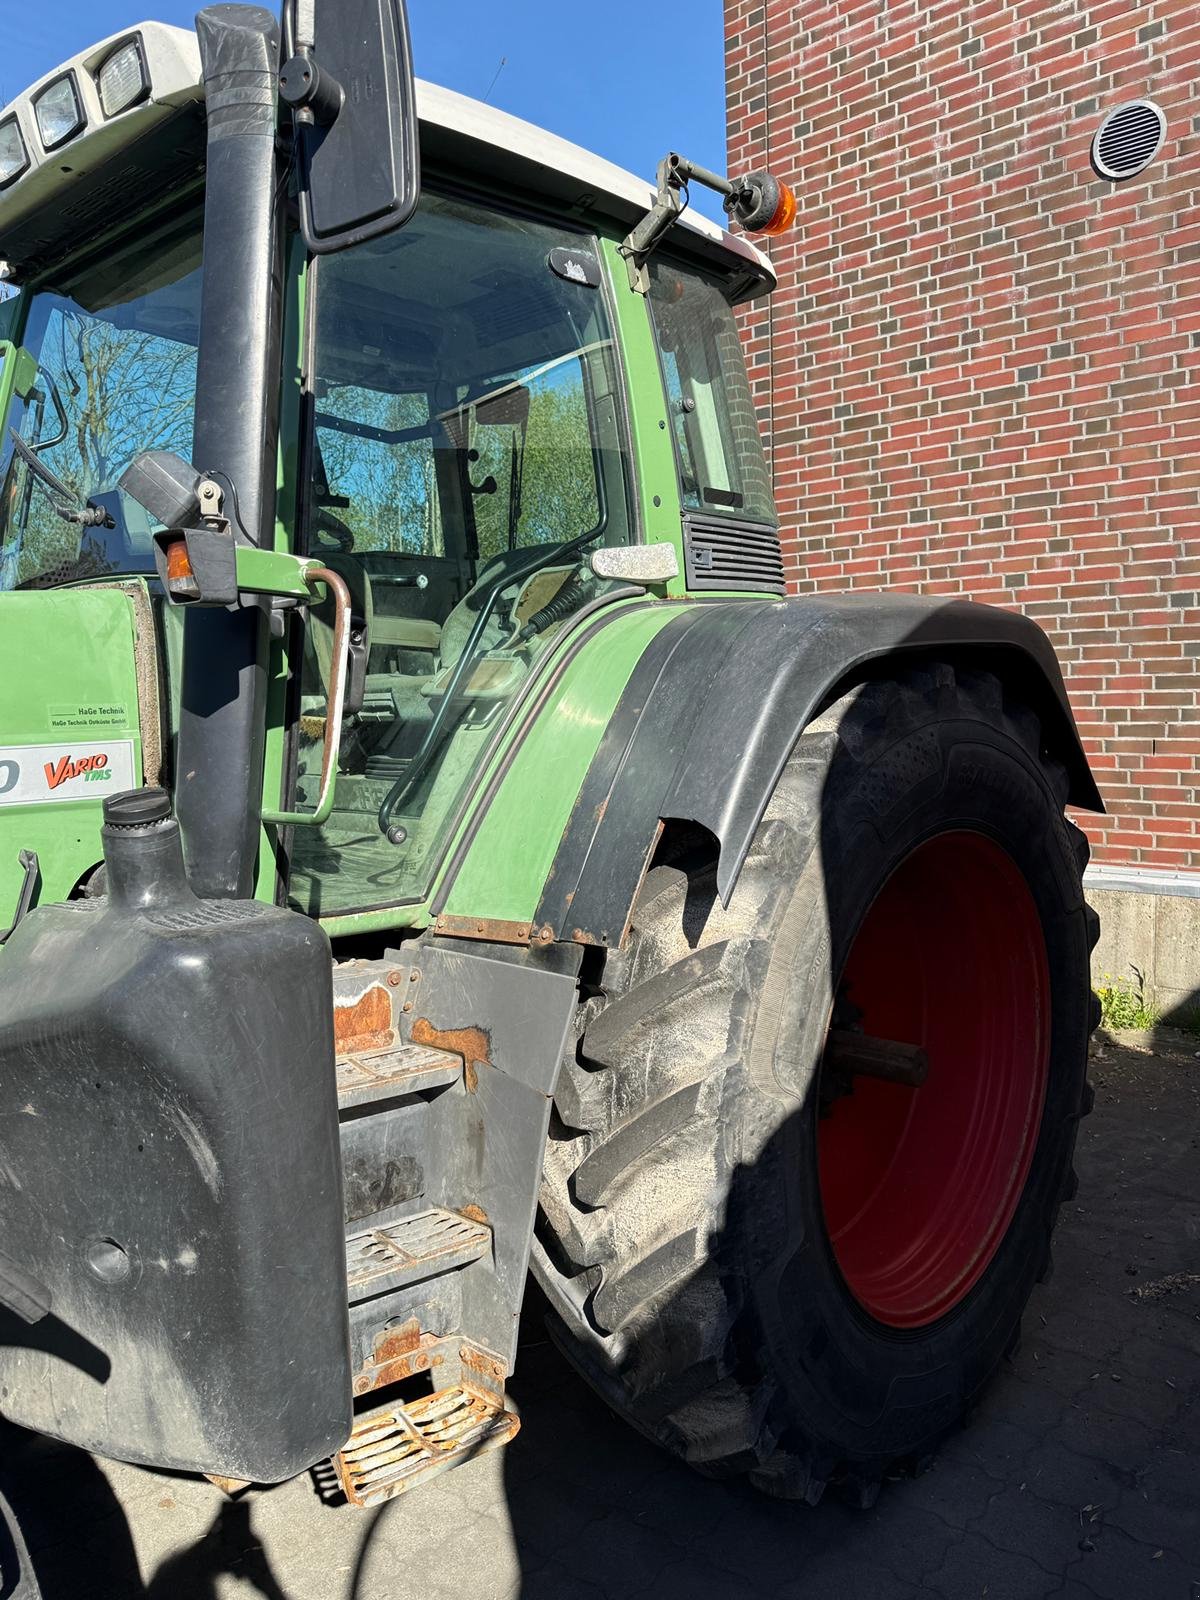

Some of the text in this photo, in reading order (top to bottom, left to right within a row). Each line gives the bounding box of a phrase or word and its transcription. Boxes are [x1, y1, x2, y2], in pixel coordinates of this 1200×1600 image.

[98, 707, 125, 715] Technik
[44, 754, 108, 789] VARIO
[83, 769, 112, 782] TMS
